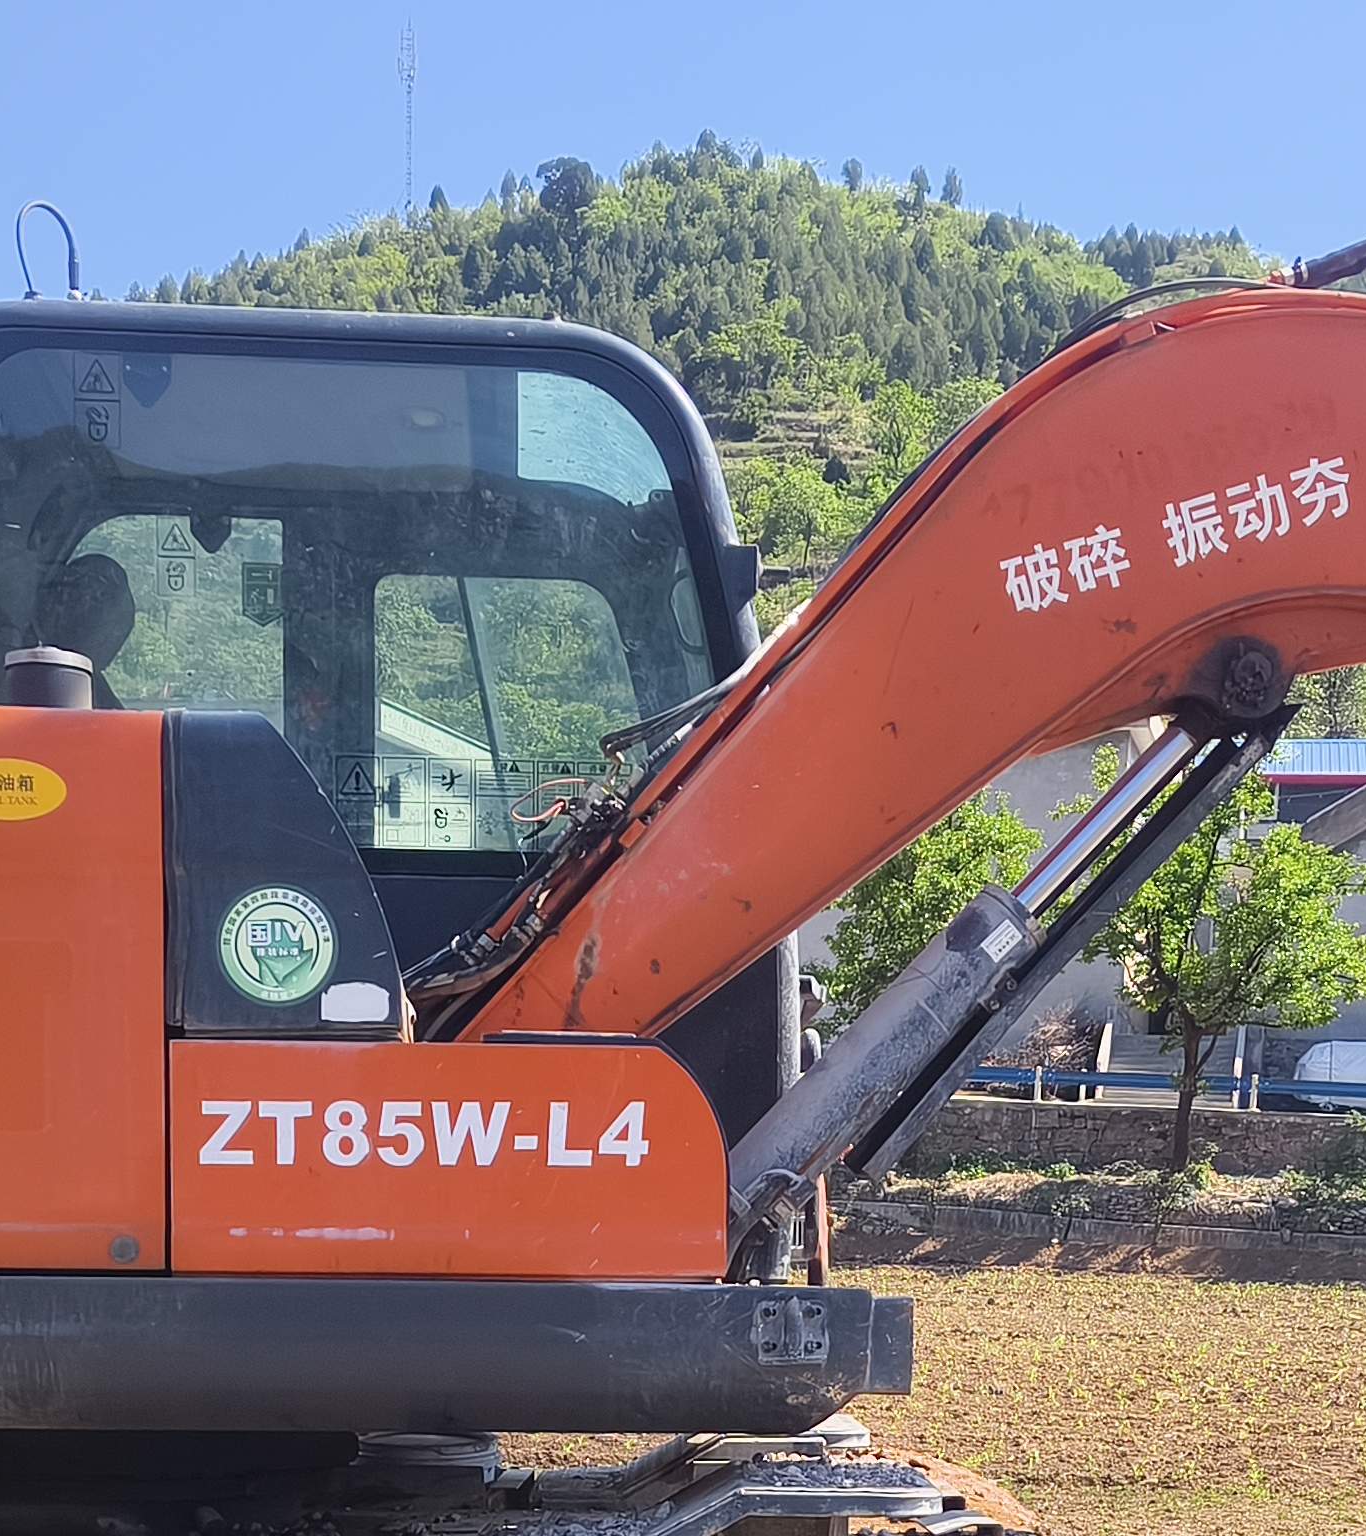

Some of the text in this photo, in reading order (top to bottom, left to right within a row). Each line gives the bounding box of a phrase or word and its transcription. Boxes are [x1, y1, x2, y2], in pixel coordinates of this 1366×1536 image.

[999, 523, 1131, 613] 破碎
[1161, 456, 1351, 568] 振动夯
[6, 795, 39, 806] TANK
[199, 1099, 650, 1168] ZT85W-L4
